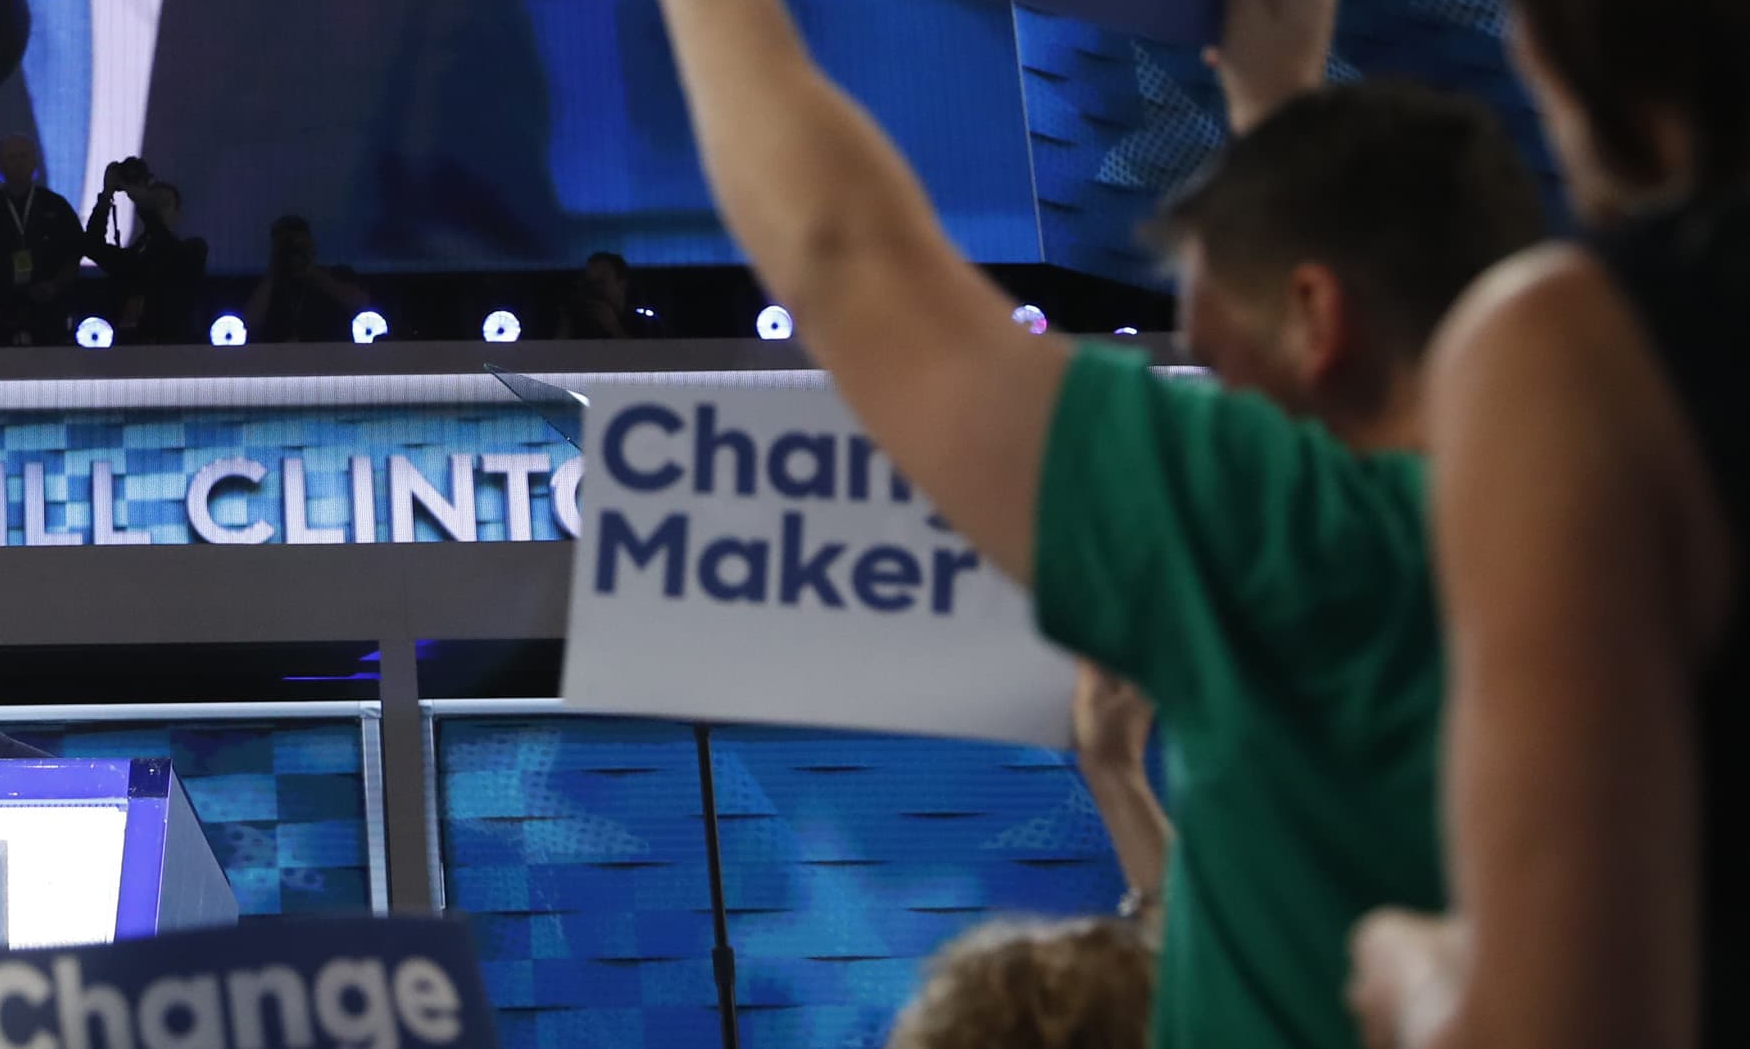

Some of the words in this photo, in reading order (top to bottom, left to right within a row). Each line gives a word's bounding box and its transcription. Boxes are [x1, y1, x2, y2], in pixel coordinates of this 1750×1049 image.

[186, 454, 584, 546] CLINT
[602, 402, 955, 531] Chan
[594, 508, 980, 616] Maker
